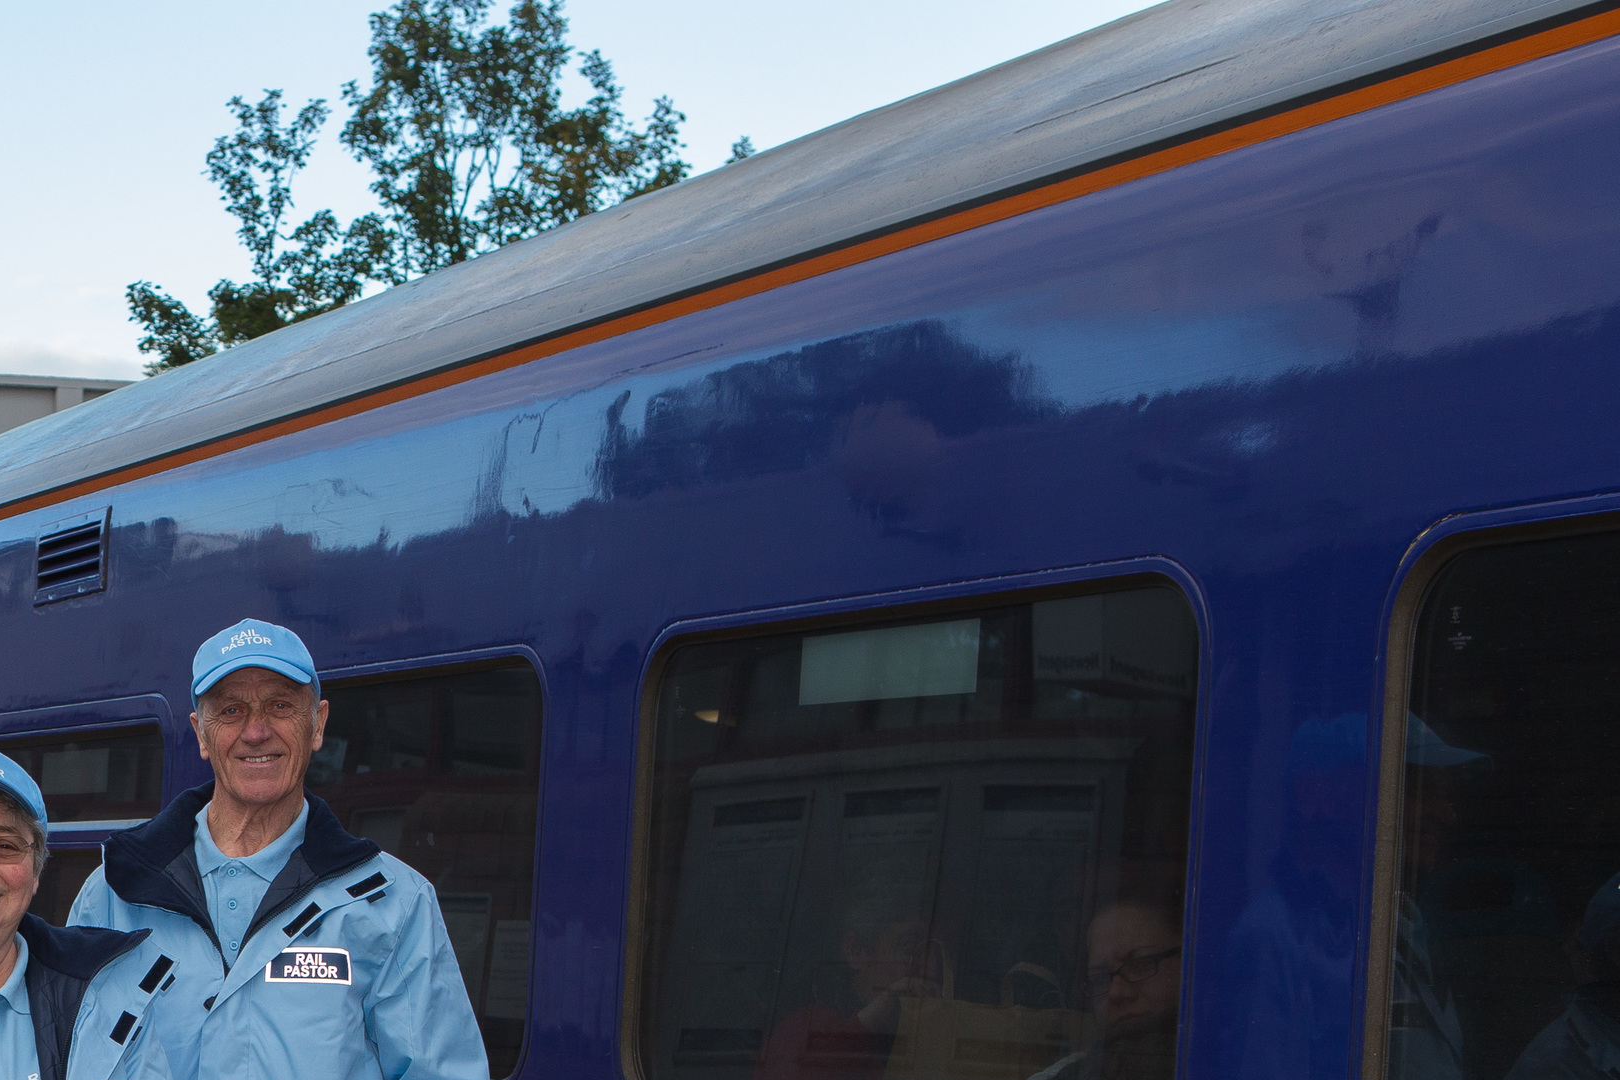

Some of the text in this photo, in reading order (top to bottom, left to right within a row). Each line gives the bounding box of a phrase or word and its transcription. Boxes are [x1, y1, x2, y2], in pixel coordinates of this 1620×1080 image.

[230, 629, 260, 643] RAIL
[221, 636, 273, 654] PASTOR
[295, 953, 327, 966] RAIL
[283, 965, 338, 979] PASTOR
